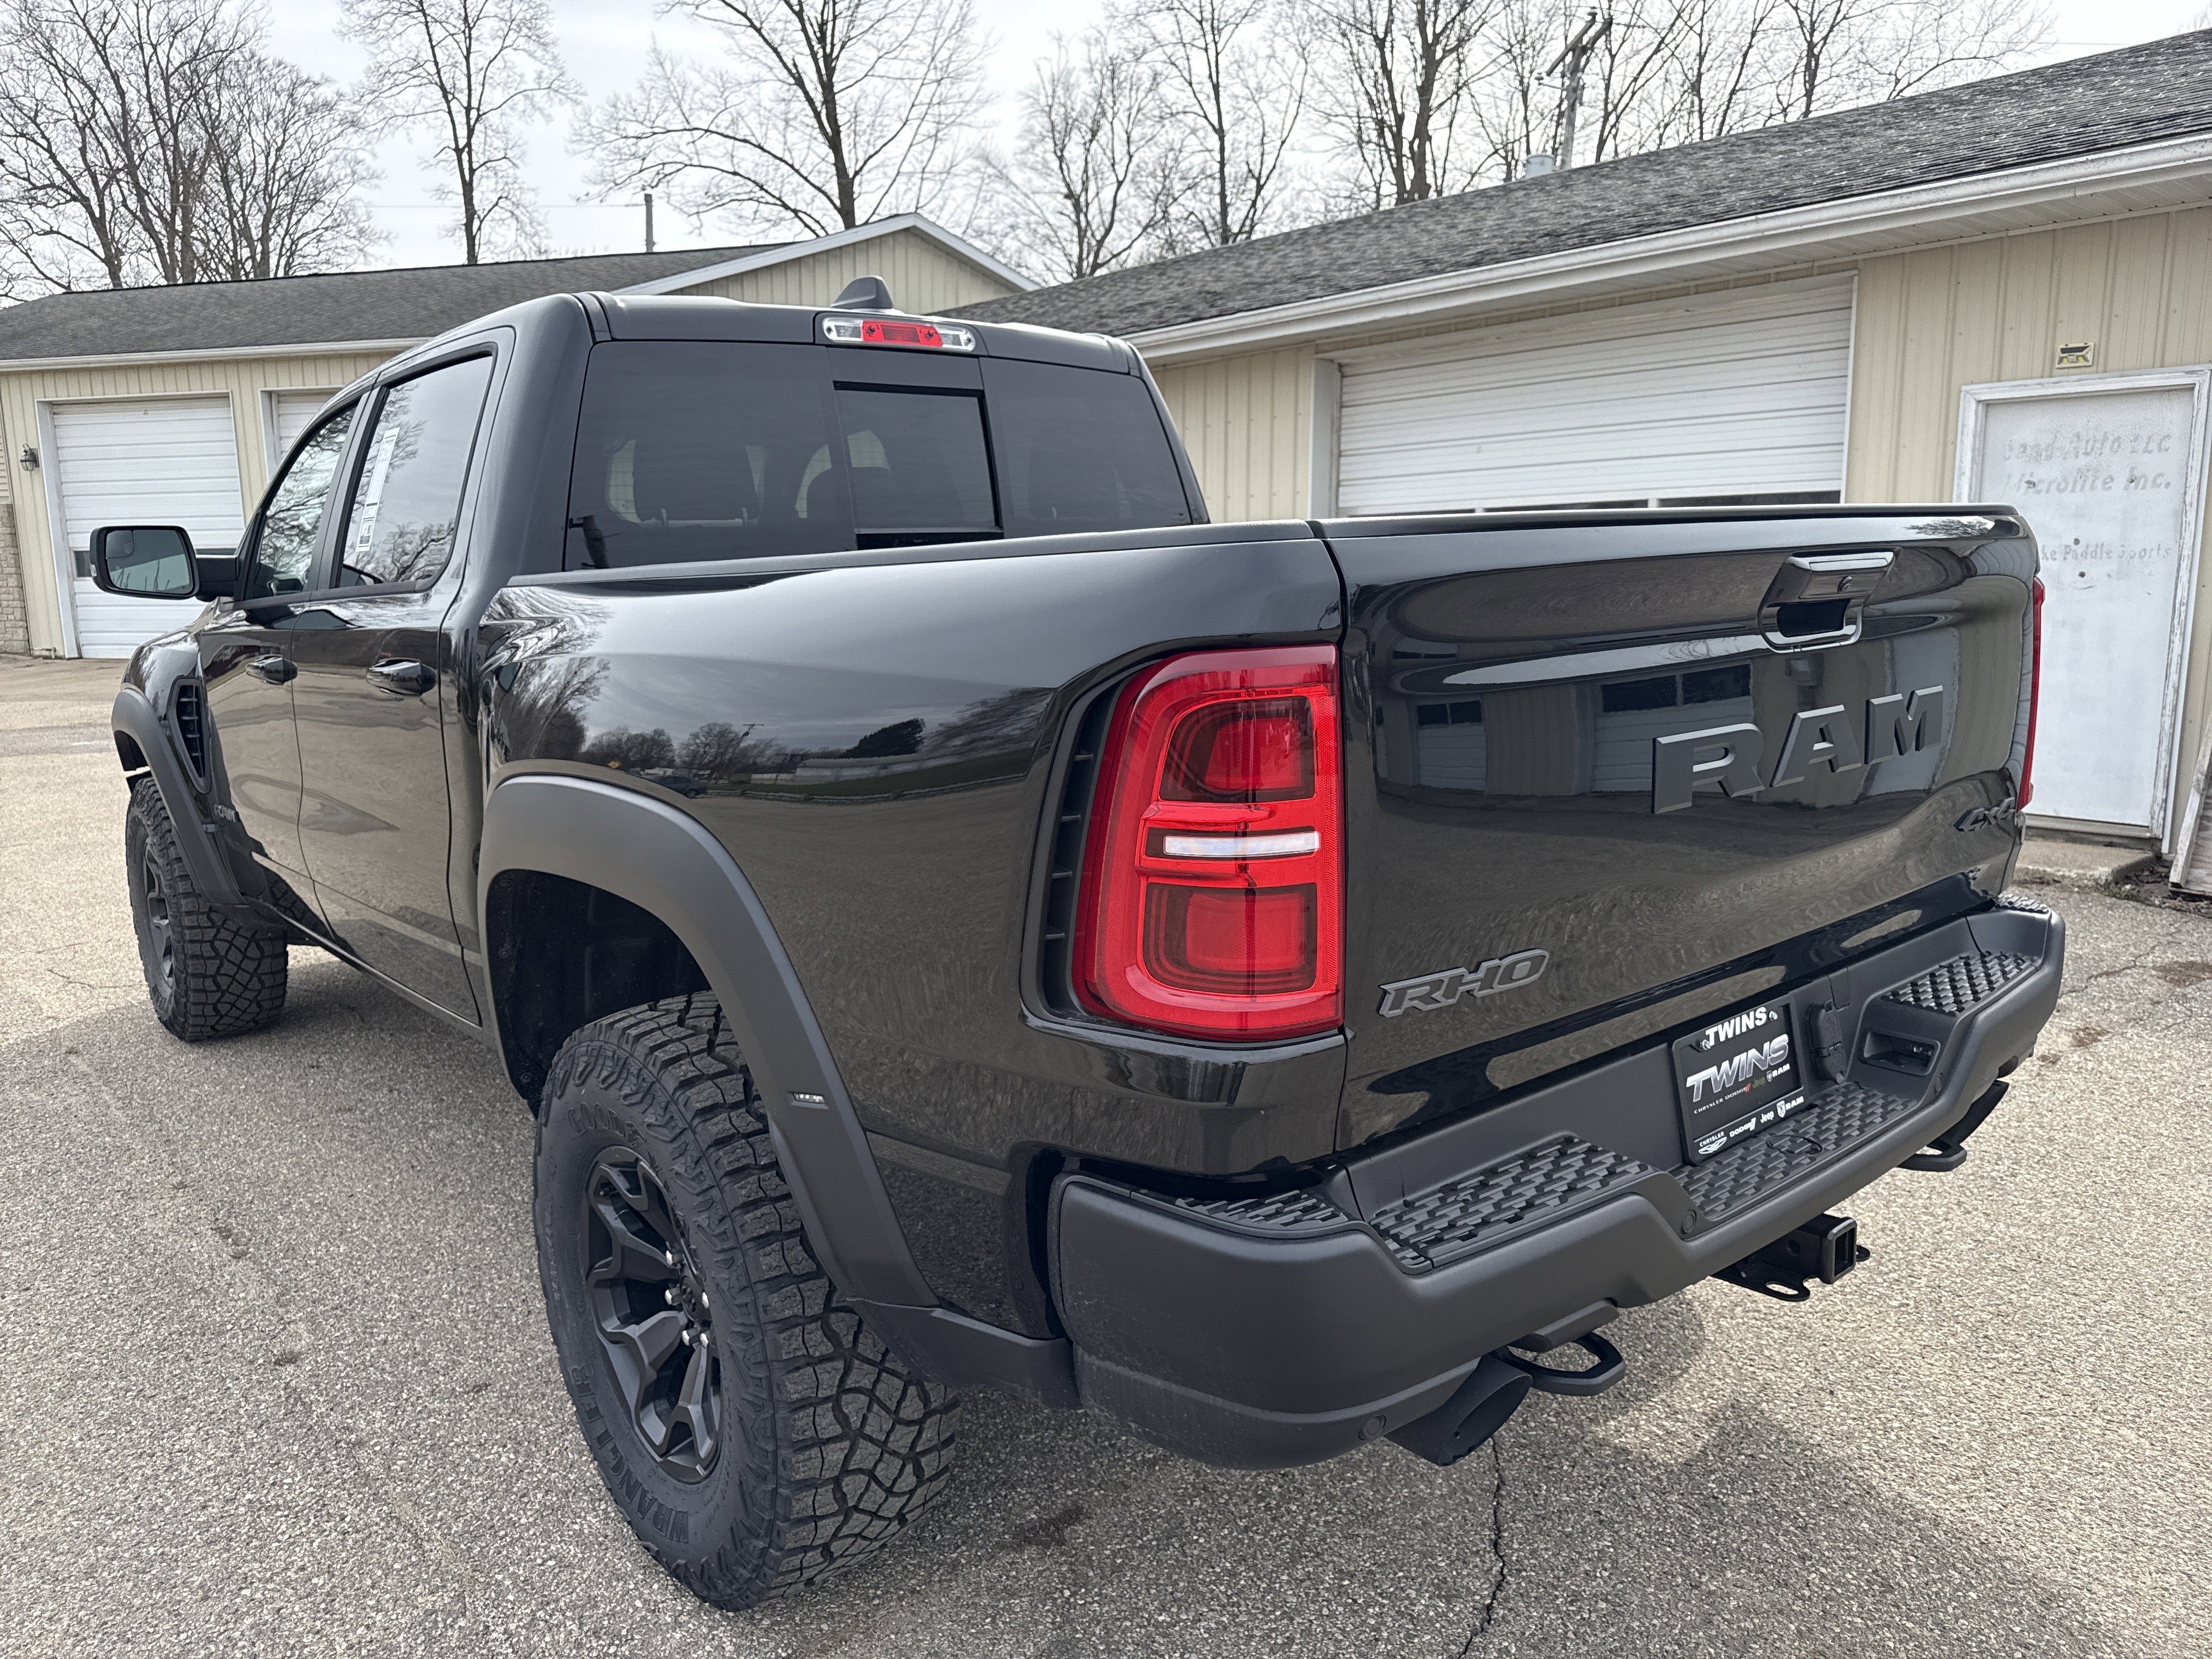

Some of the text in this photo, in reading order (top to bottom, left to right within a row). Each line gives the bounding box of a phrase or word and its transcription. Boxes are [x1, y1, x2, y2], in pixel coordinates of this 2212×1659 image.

[2123, 466, 2171, 491] Inc.
[1651, 685, 1944, 815] RAM
[1378, 948, 1550, 1018] RHO
[1705, 1006, 1767, 1047] TWINS
[1685, 1034, 1789, 1103] TWINS
[1694, 1098, 1724, 1114] CHRYSLER
[1752, 1077, 1766, 1088] Jeep
[1772, 1063, 1791, 1077] RAM
[1760, 1110, 1774, 1124] Jeep
[1785, 1096, 1804, 1110] RAM
[1699, 1131, 1725, 1147] CHRYSLER
[571, 1364, 689, 1544] WRANGLER
